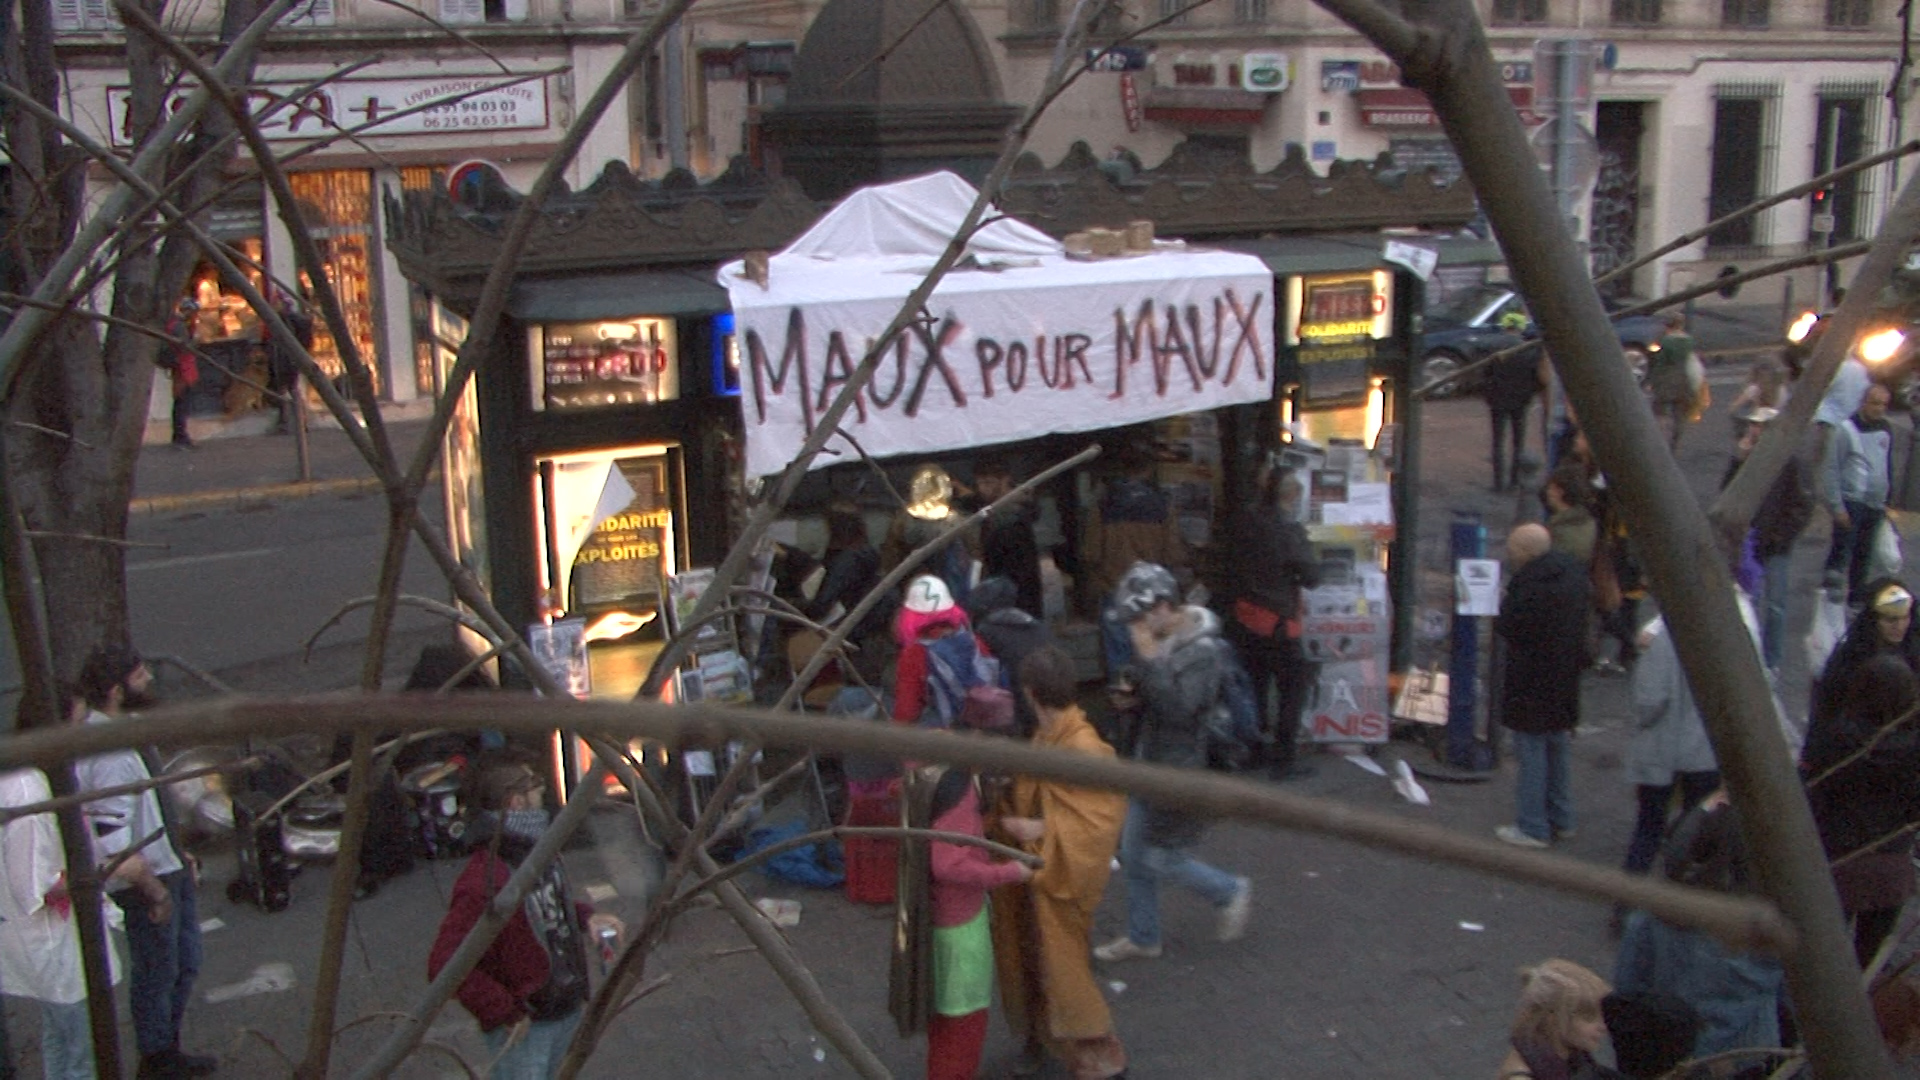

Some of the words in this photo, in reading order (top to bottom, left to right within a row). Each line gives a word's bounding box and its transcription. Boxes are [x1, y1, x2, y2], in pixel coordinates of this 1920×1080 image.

[481, 101, 497, 112] 03
[500, 101, 517, 112] 03
[424, 117, 440, 128] 06
[746, 306, 967, 443] MAUX
[976, 332, 1093, 398] POUR
[1108, 288, 1265, 399] MAUX
[575, 542, 660, 565] XPLOITÉS
